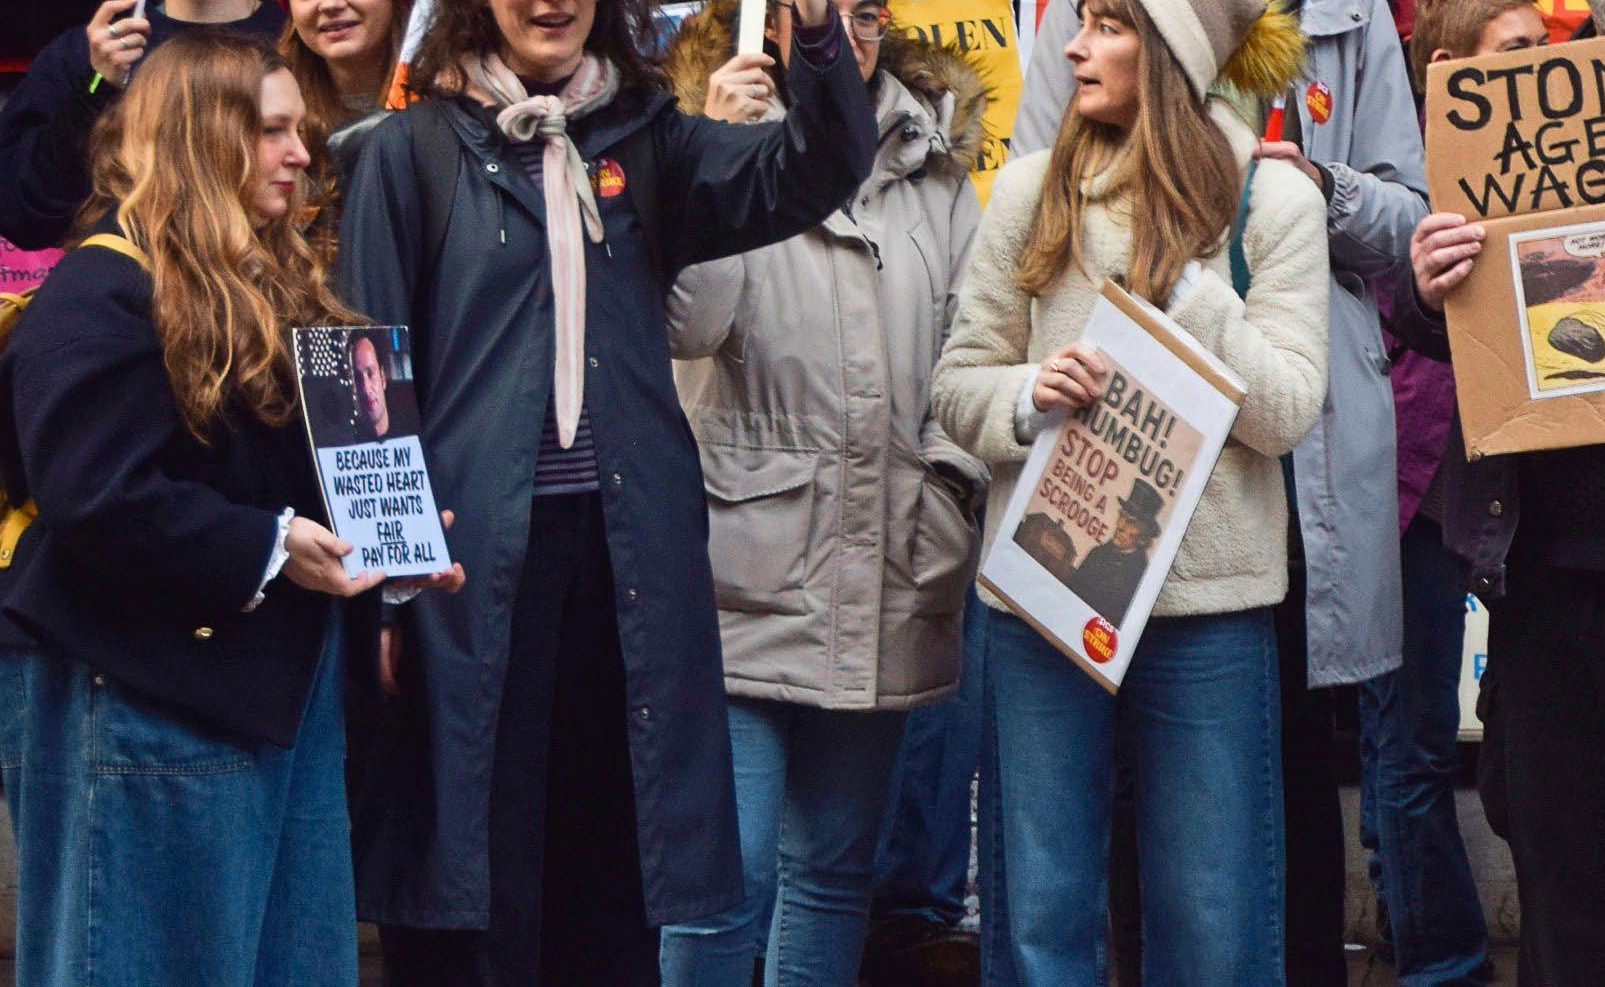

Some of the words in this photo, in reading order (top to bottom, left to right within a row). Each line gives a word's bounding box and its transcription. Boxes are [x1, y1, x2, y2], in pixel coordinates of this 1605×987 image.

[1104, 370, 1177, 449] BAH!
[336, 447, 390, 471] BECAUSE
[394, 447, 411, 468] MY
[1061, 428, 1120, 486] STOP
[334, 473, 383, 495] WASTED
[387, 471, 424, 492] HEART
[1052, 458, 1096, 502] BEING
[1095, 495, 1109, 516] A
[348, 498, 376, 519] JUST
[380, 494, 424, 517] WANTS
[1040, 478, 1109, 543] SCROOGE
[376, 520, 405, 541] FAIR
[362, 546, 383, 567] PAY
[386, 543, 411, 564] FOR
[414, 542, 436, 563] ALL
[1084, 628, 1114, 660] STRIKE
[1092, 627, 1110, 646] ON
